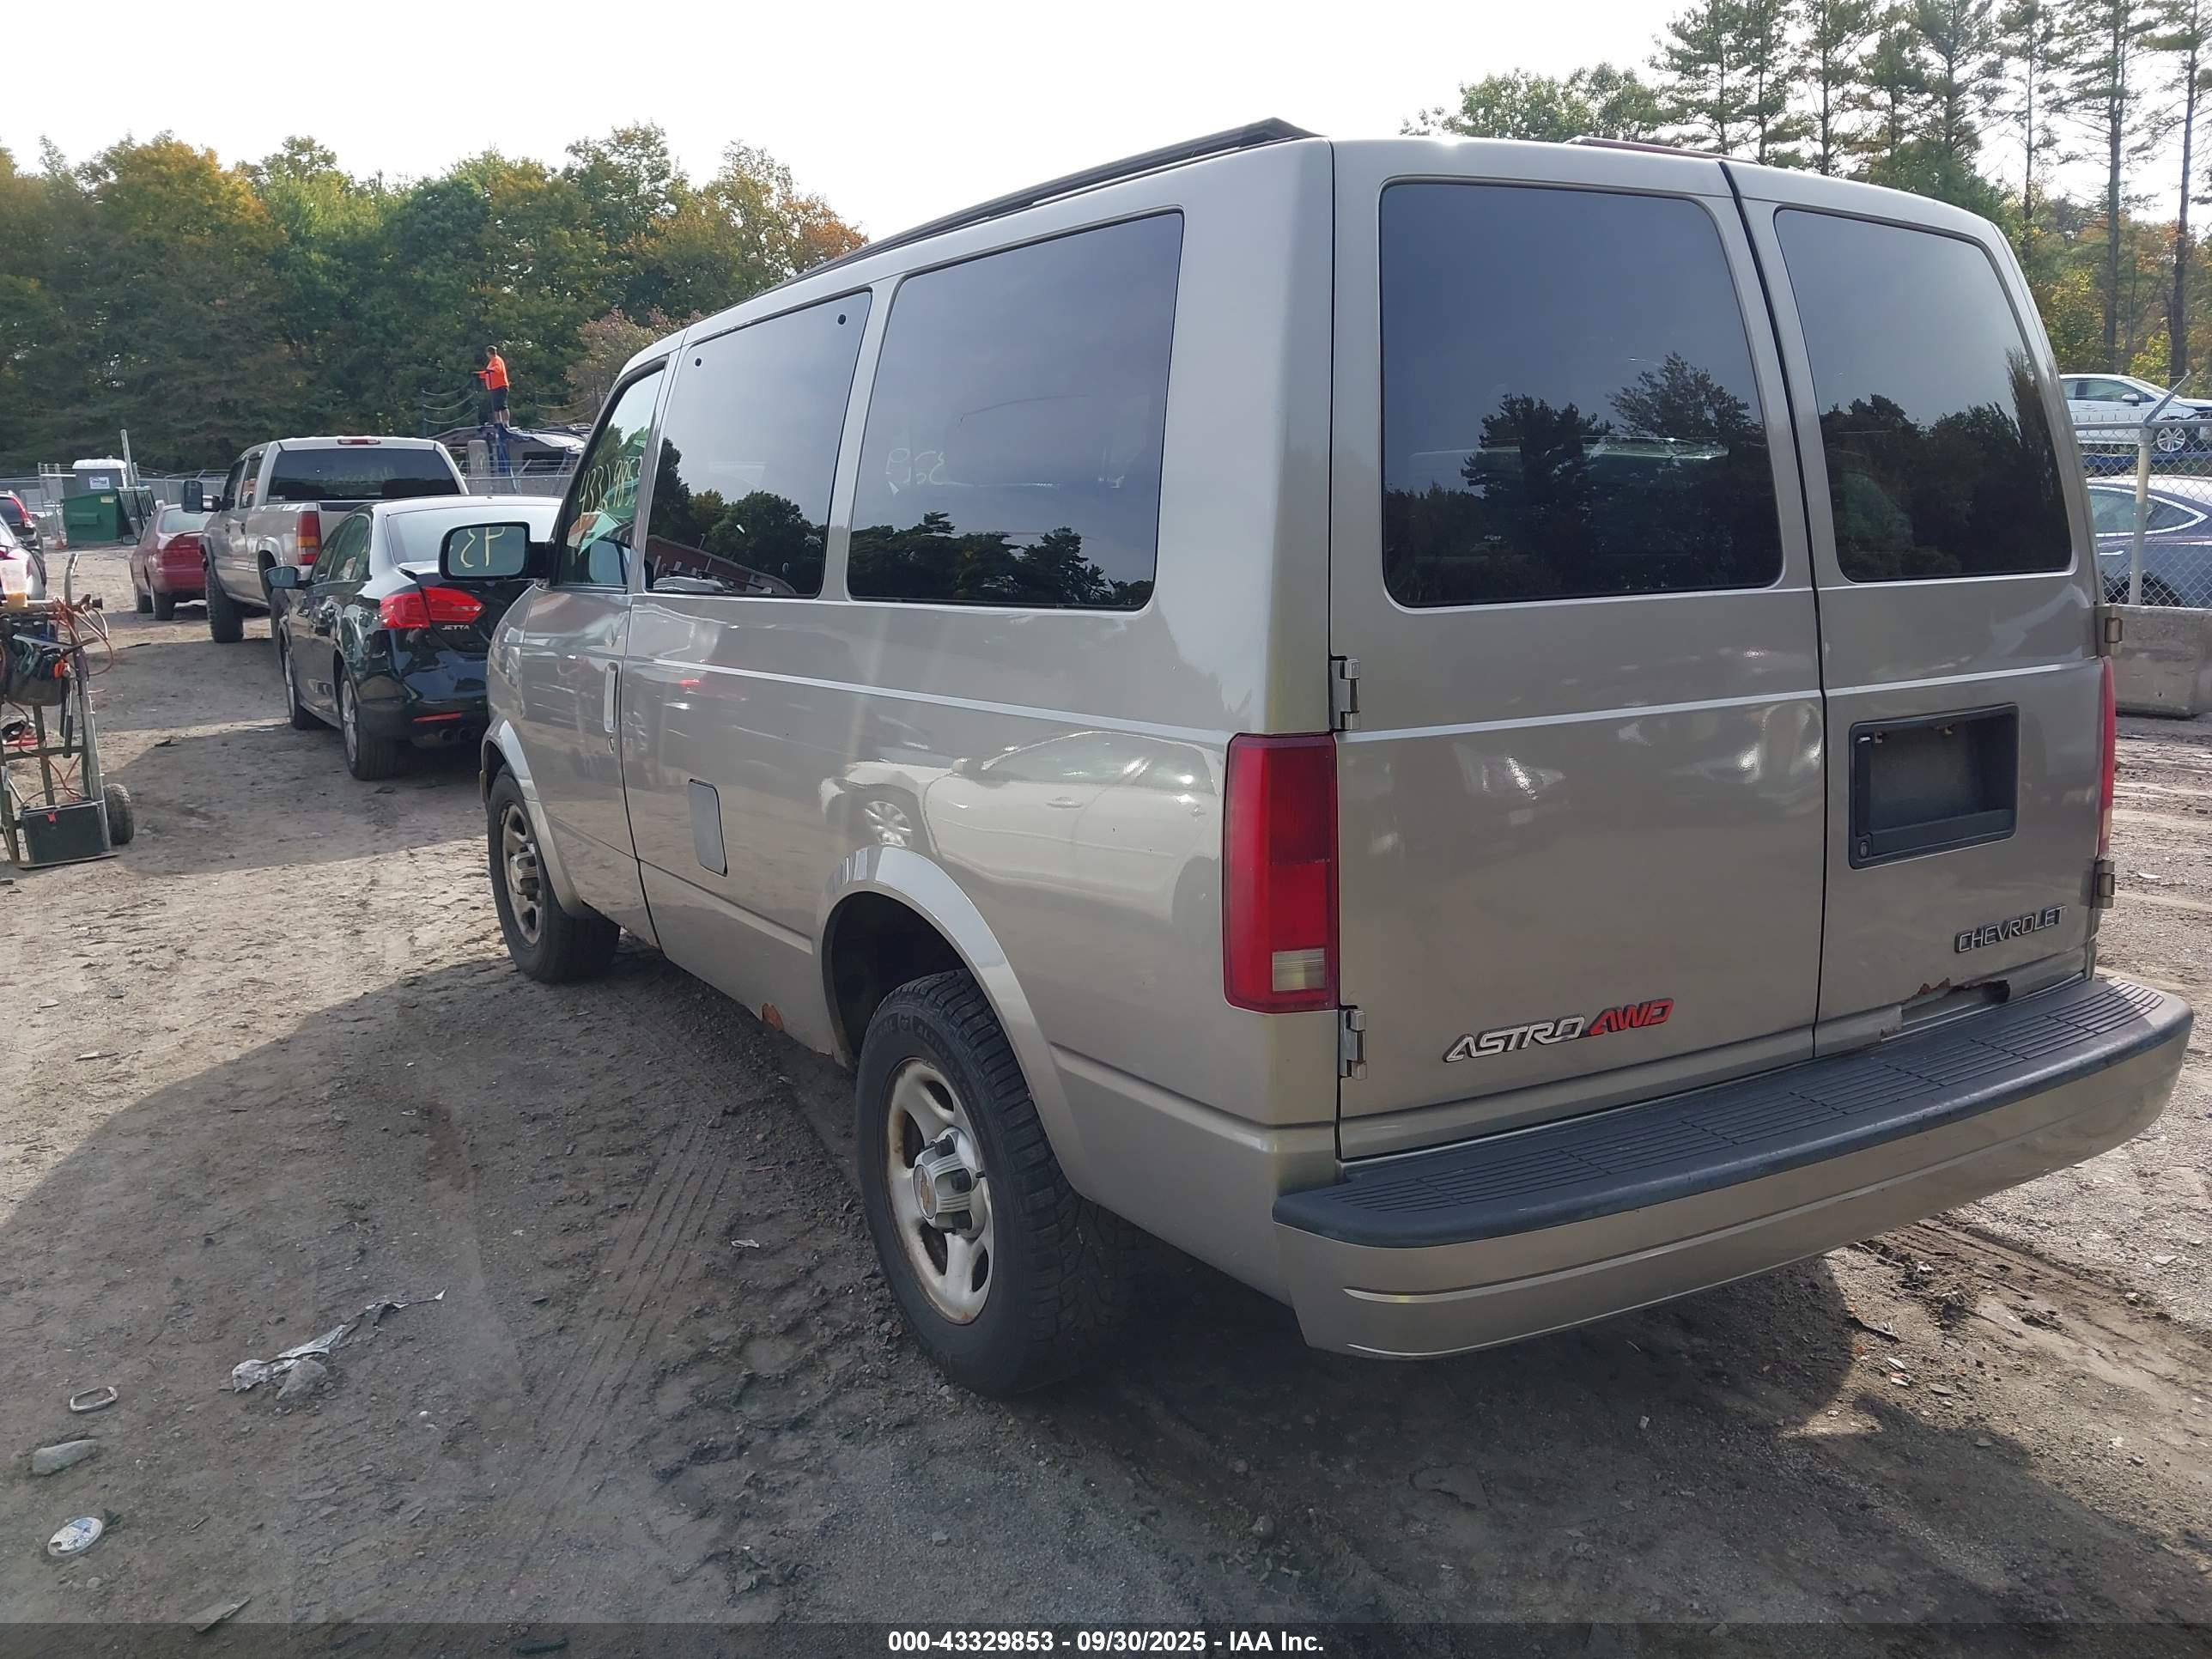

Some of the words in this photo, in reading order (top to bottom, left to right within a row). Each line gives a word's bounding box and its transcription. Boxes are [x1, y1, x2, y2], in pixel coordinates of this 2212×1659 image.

[1954, 902, 2068, 954] CHEVROLET
[1443, 1013, 1586, 1063] ASTRO
[1589, 997, 1674, 1036] AWD
